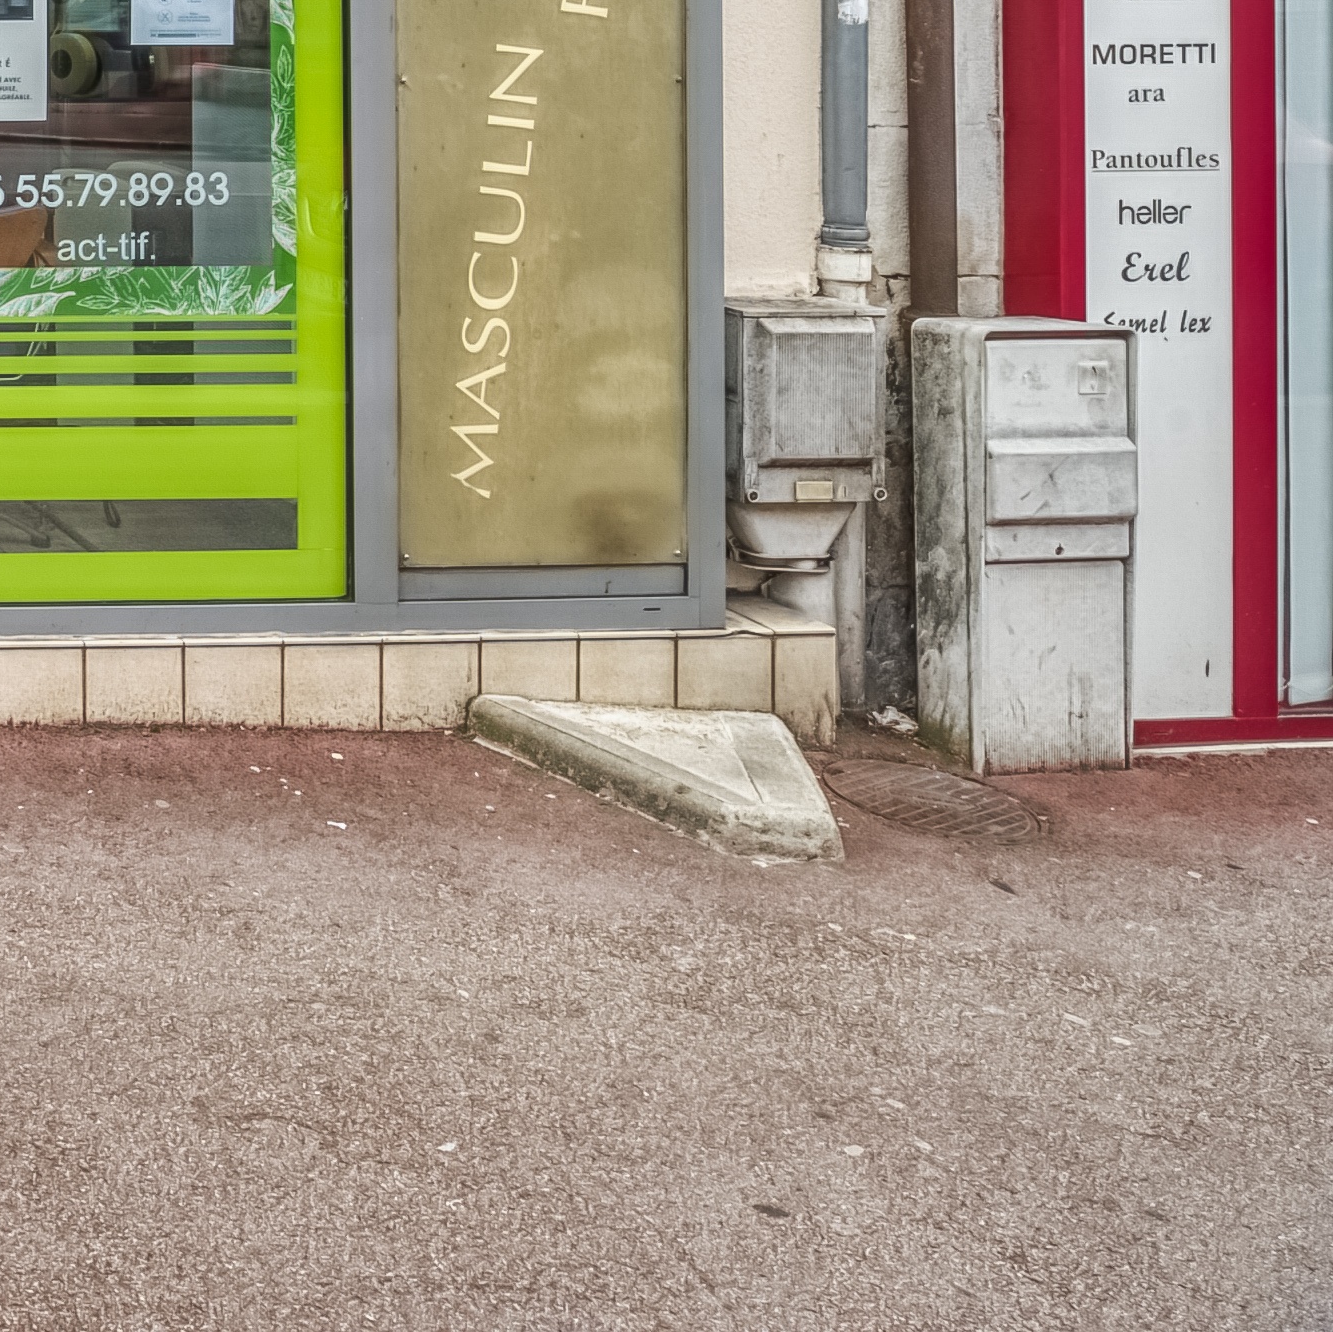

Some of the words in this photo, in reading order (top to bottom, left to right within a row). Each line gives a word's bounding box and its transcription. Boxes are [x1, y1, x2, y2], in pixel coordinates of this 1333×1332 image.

[1092, 43, 1217, 65] MORETTI
[1128, 85, 1166, 103] ara
[1090, 146, 1221, 170] Pantoufles
[16, 171, 230, 208] 55.79.89.83
[1118, 199, 1191, 225] heller
[449, 43, 544, 500] MASCULIN
[1121, 251, 1191, 283] Erel
